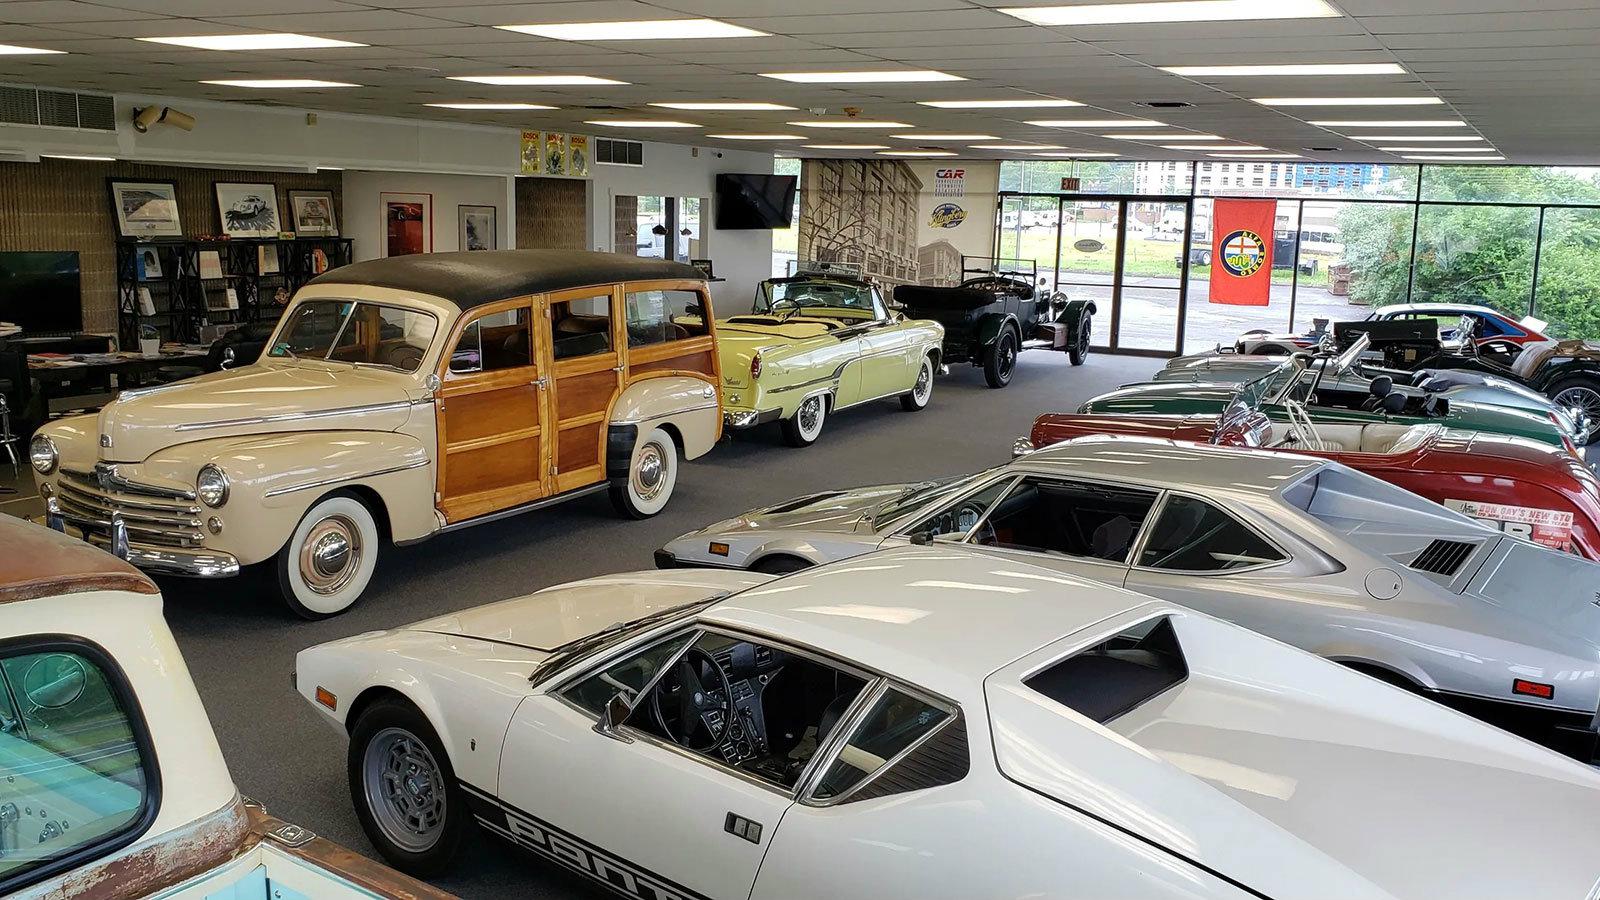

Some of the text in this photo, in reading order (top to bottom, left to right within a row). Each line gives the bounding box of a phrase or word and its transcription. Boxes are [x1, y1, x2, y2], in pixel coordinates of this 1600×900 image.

[936, 169, 965, 179] CAR
[1242, 231, 1262, 246] ALFA
[1528, 510, 1551, 520] NEW
